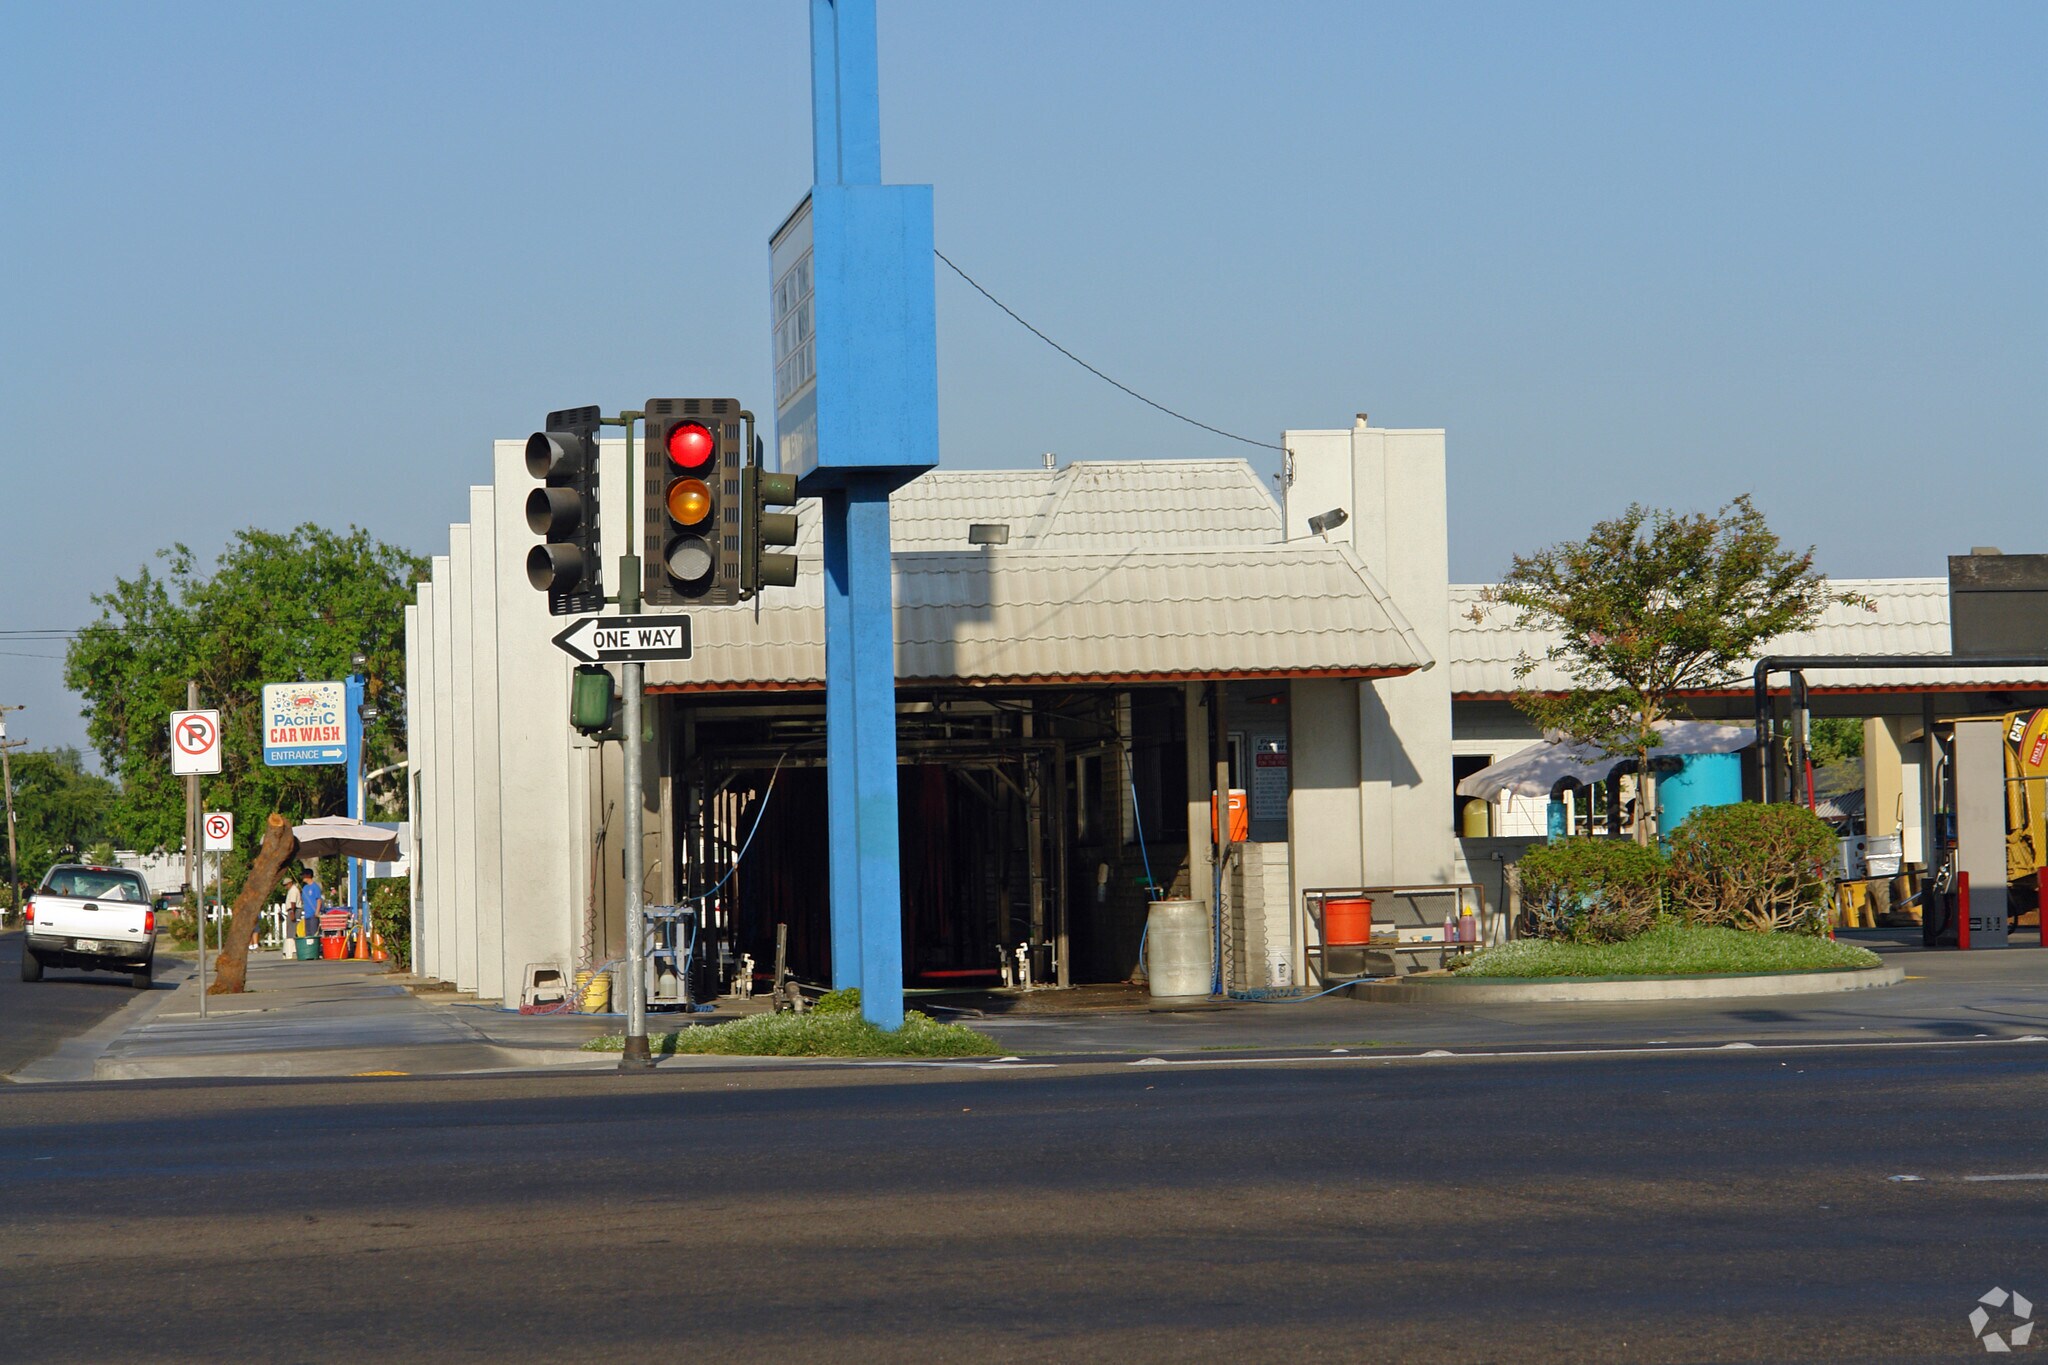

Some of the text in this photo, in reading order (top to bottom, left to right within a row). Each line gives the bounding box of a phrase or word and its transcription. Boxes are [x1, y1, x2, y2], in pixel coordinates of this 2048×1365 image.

[593, 628, 676, 648] ONE WAY
[274, 711, 336, 726] PACIFIC
[270, 726, 340, 743] CAR WASH
[2009, 717, 2027, 742] CAT
[271, 750, 319, 761] ENTRANCE
